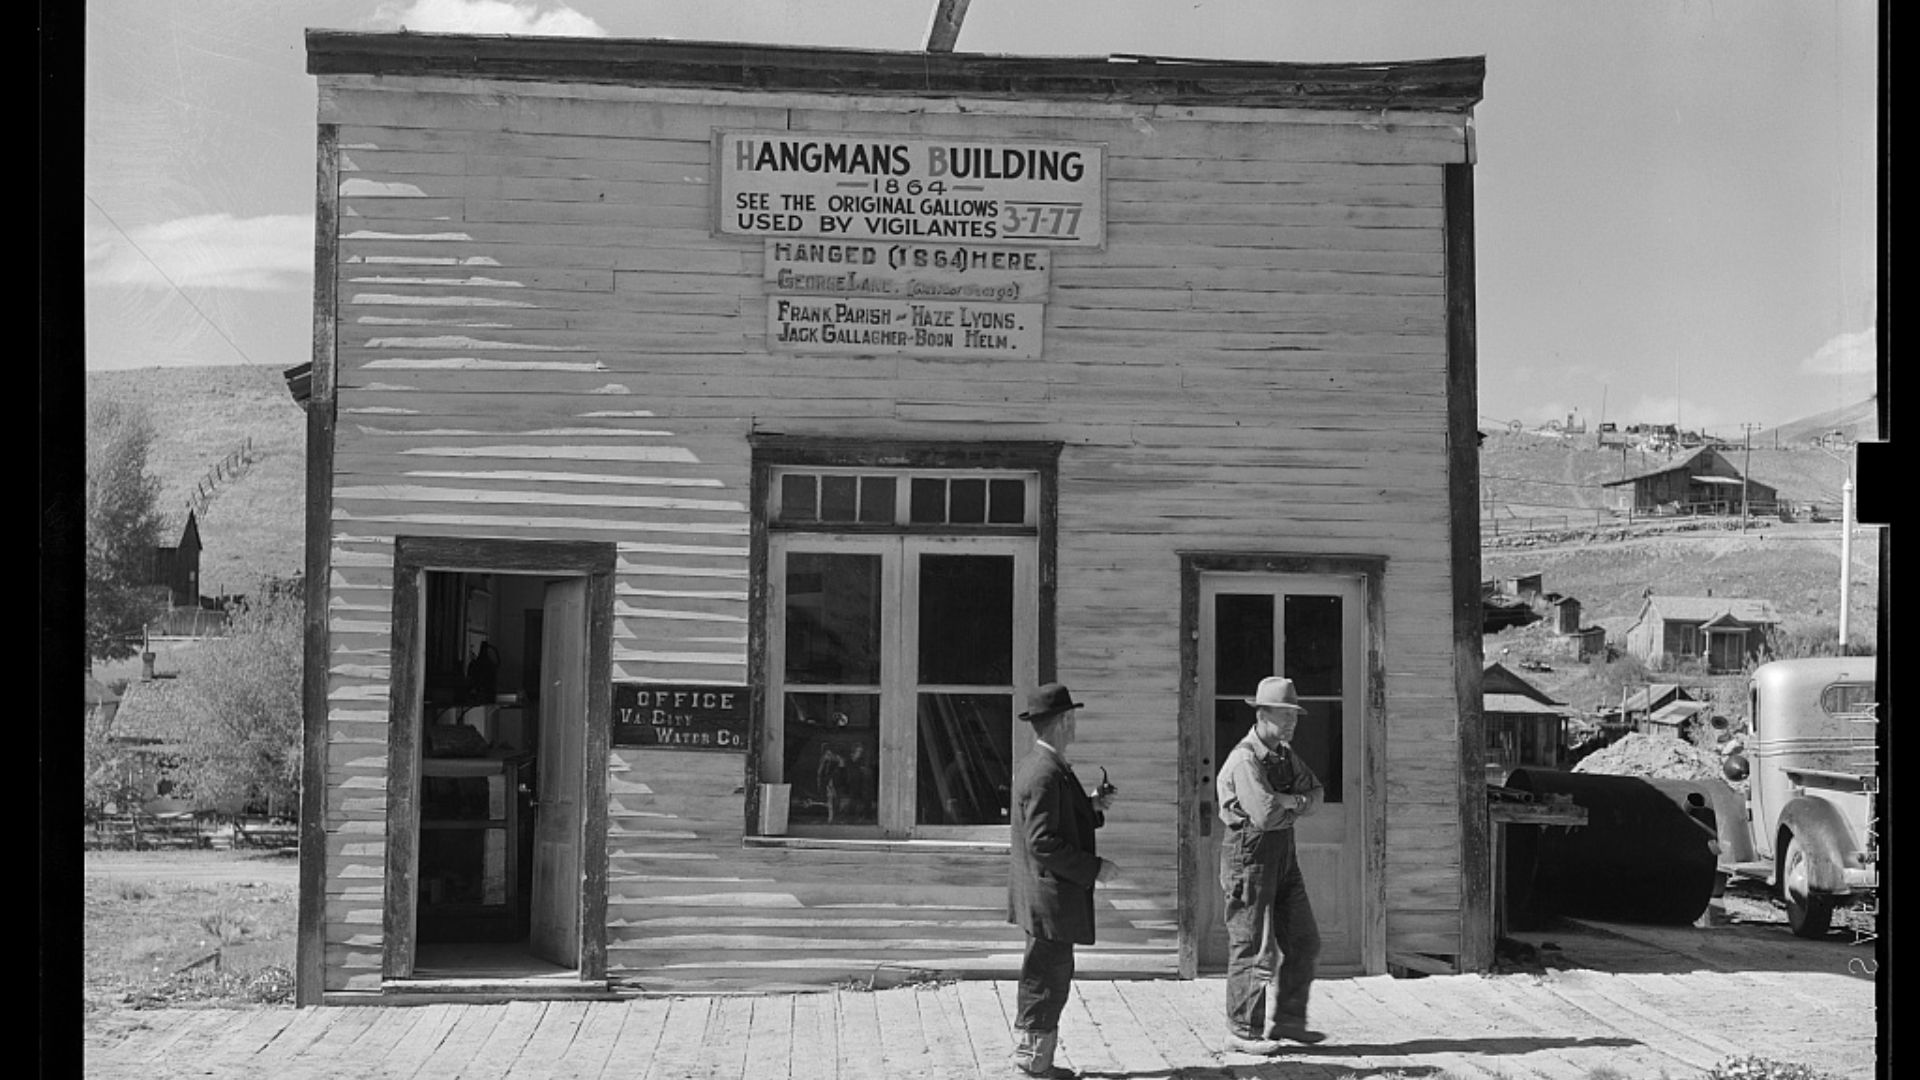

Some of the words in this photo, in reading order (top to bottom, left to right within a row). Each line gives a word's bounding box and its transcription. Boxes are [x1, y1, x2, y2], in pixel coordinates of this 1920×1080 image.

[736, 140, 911, 175] HANGMANS
[928, 145, 1085, 182] BUILDING
[872, 178, 948, 196] 1864
[736, 193, 770, 211] SEE
[780, 194, 816, 212] THE
[828, 195, 915, 216] ORIGINAL
[920, 199, 999, 218] GALLOWS
[738, 213, 803, 232] USED
[819, 215, 853, 233] BY
[865, 217, 997, 238] VIGILANTES
[1002, 205, 1083, 236] 3-7-77
[774, 243, 877, 266] HANGED
[636, 690, 735, 710] OFFICE
